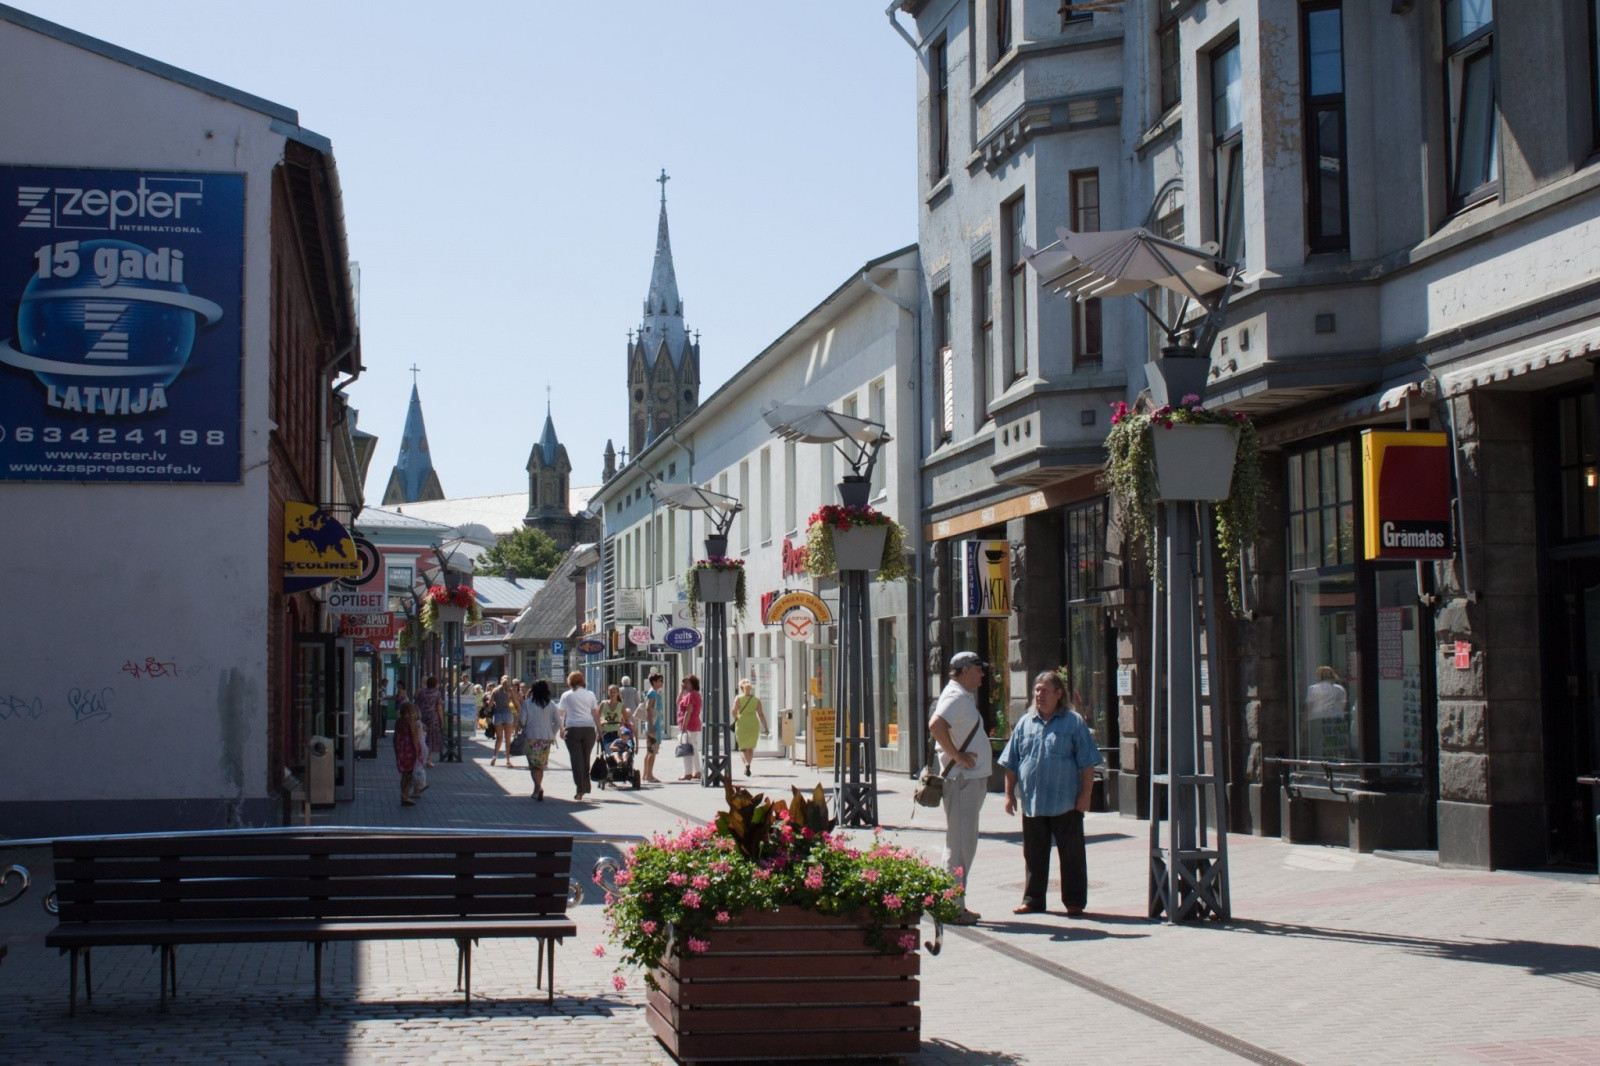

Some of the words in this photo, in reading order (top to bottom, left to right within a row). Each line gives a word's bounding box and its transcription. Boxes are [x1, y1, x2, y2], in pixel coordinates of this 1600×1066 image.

[55, 177, 203, 230] zepter
[119, 225, 203, 233] INTERNATIONAL
[34, 240, 80, 279] 15
[93, 247, 184, 288] gadi
[47, 382, 168, 415] LATVIJĀ
[15, 426, 225, 446] 63424198
[45, 449, 167, 462] www.zepter.lv
[9, 462, 202, 475] www.zespressocafe.lv
[1382, 521, 1444, 548] Grāmatas
[329, 594, 382, 607] OPTIBET
[982, 576, 1009, 610] AKTA
[674, 630, 693, 640] zelts
[554, 642, 562, 654] P
